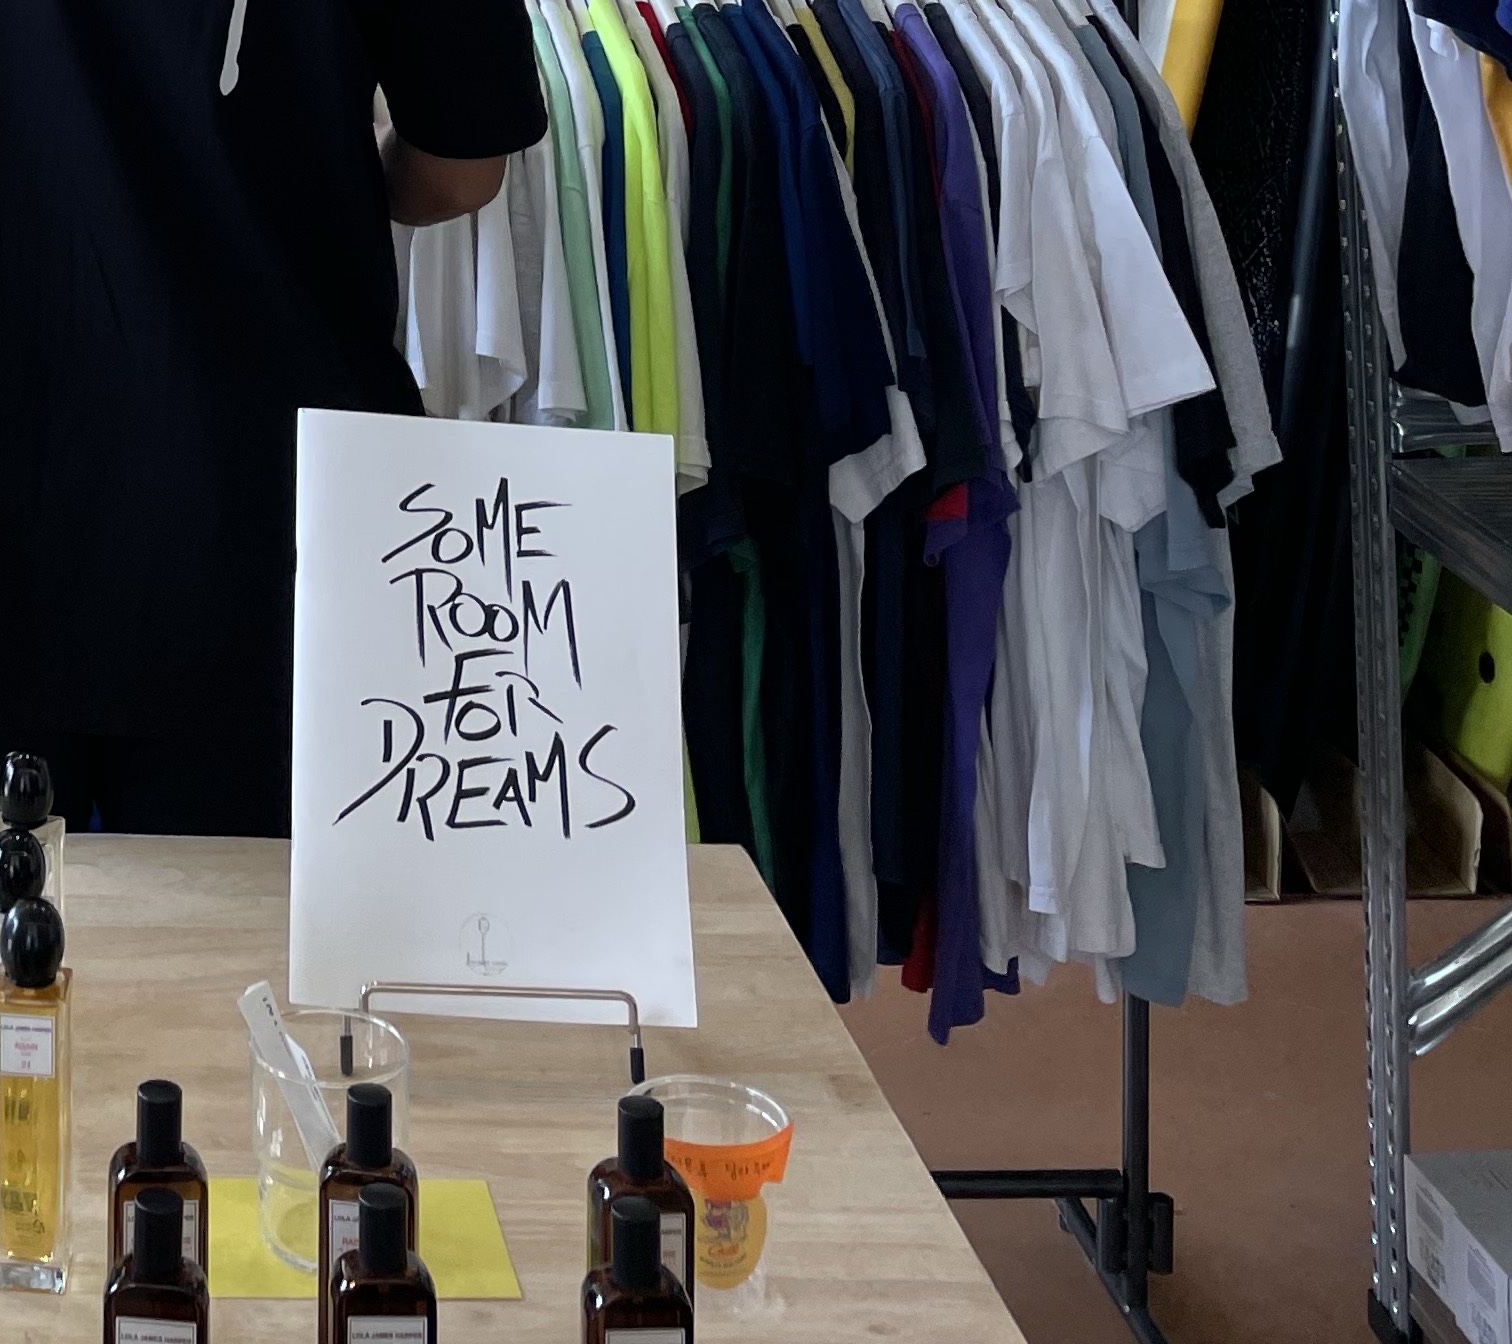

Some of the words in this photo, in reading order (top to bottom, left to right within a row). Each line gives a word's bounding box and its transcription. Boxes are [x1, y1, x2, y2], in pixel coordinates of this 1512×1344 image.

[382, 477, 572, 602] SOME
[390, 567, 582, 690] ROOM
[424, 649, 563, 745] FOR
[332, 698, 636, 841] DREAMS
